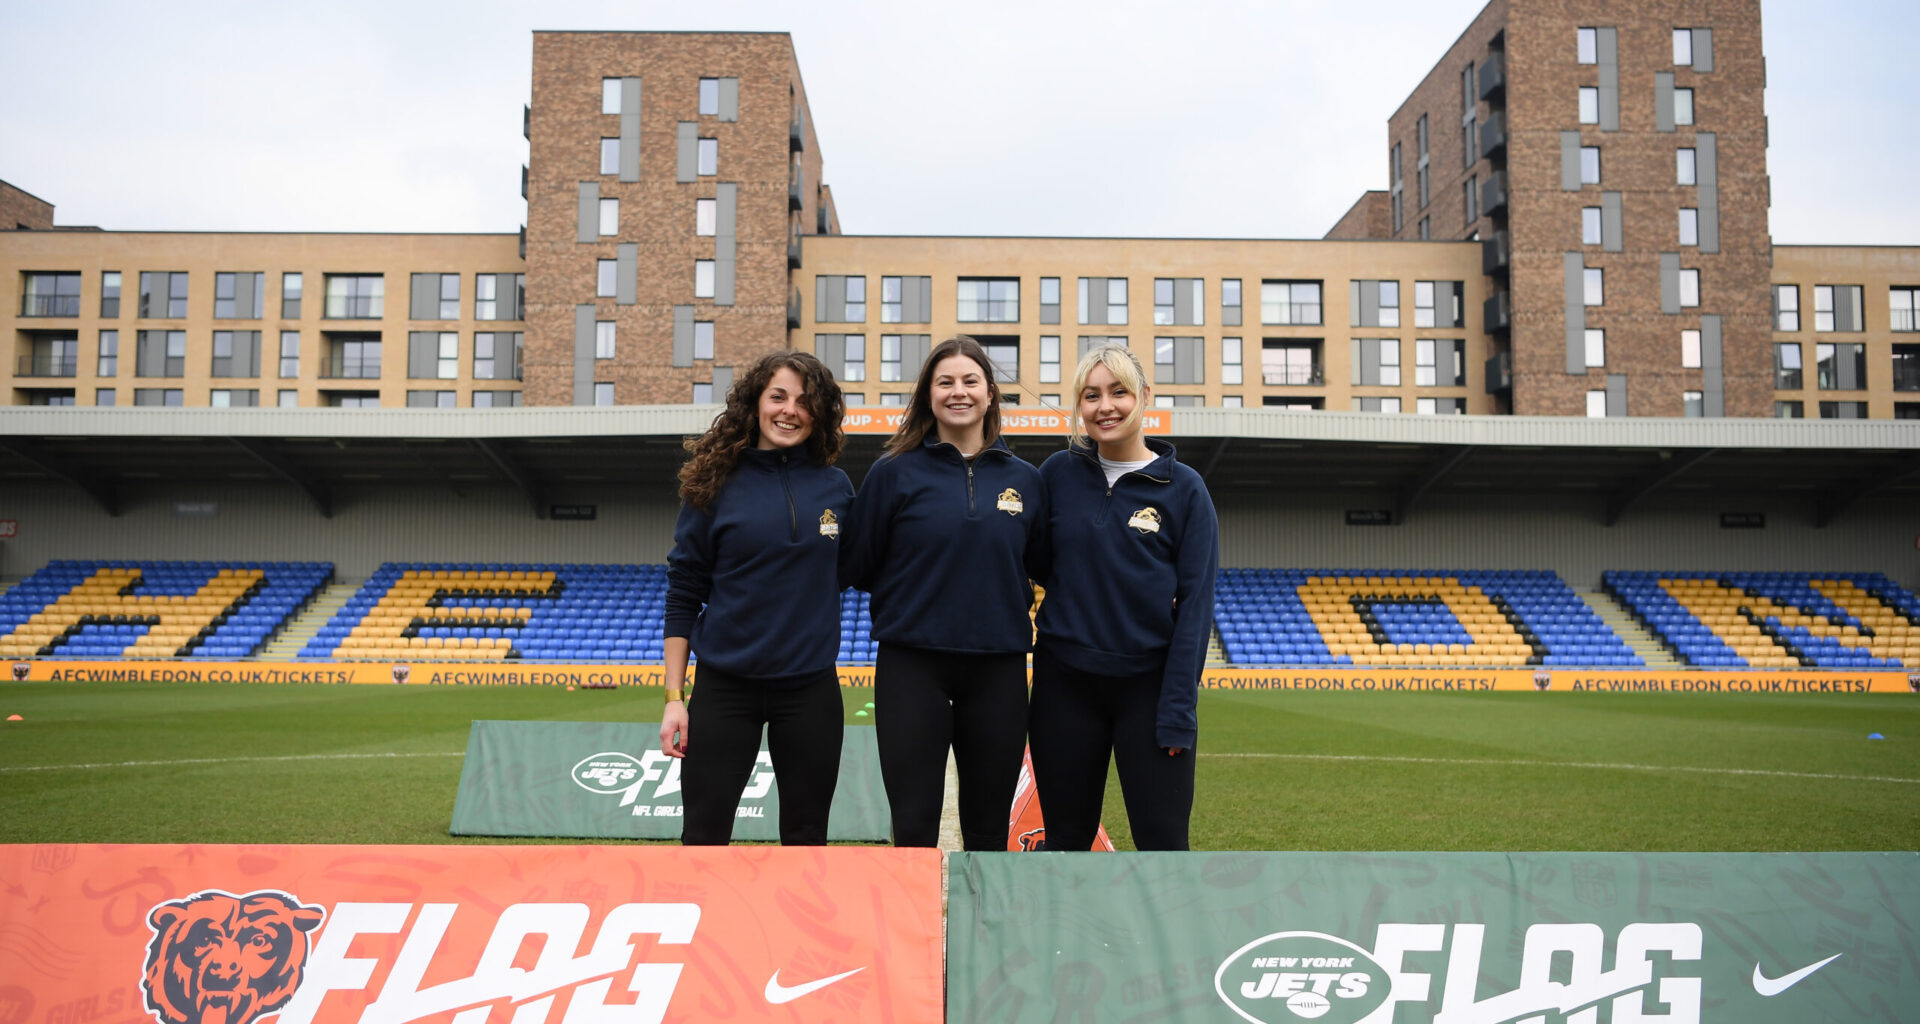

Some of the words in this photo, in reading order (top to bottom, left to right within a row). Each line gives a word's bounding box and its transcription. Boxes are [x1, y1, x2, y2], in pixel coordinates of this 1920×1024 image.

[841, 414, 872, 426] OUP
[1001, 415, 1060, 427] RUSTED
[50, 669, 355, 684] AFCWIMBLEDON.CO.UK/TICKETS/
[1572, 679, 1872, 692] AFCWIMBLEDON.CO.UK/TICKETS/
[581, 768, 637, 779] JETS
[619, 749, 775, 807] FLG
[632, 805, 652, 816] NFL
[653, 805, 683, 816] GIRLS
[735, 806, 764, 817] TBALL
[274, 902, 701, 1024] FLAG
[1252, 957, 1299, 968] NEW
[1300, 957, 1355, 968] YORK
[1352, 922, 1703, 1024] FLAG
[1240, 972, 1371, 999] JETS
